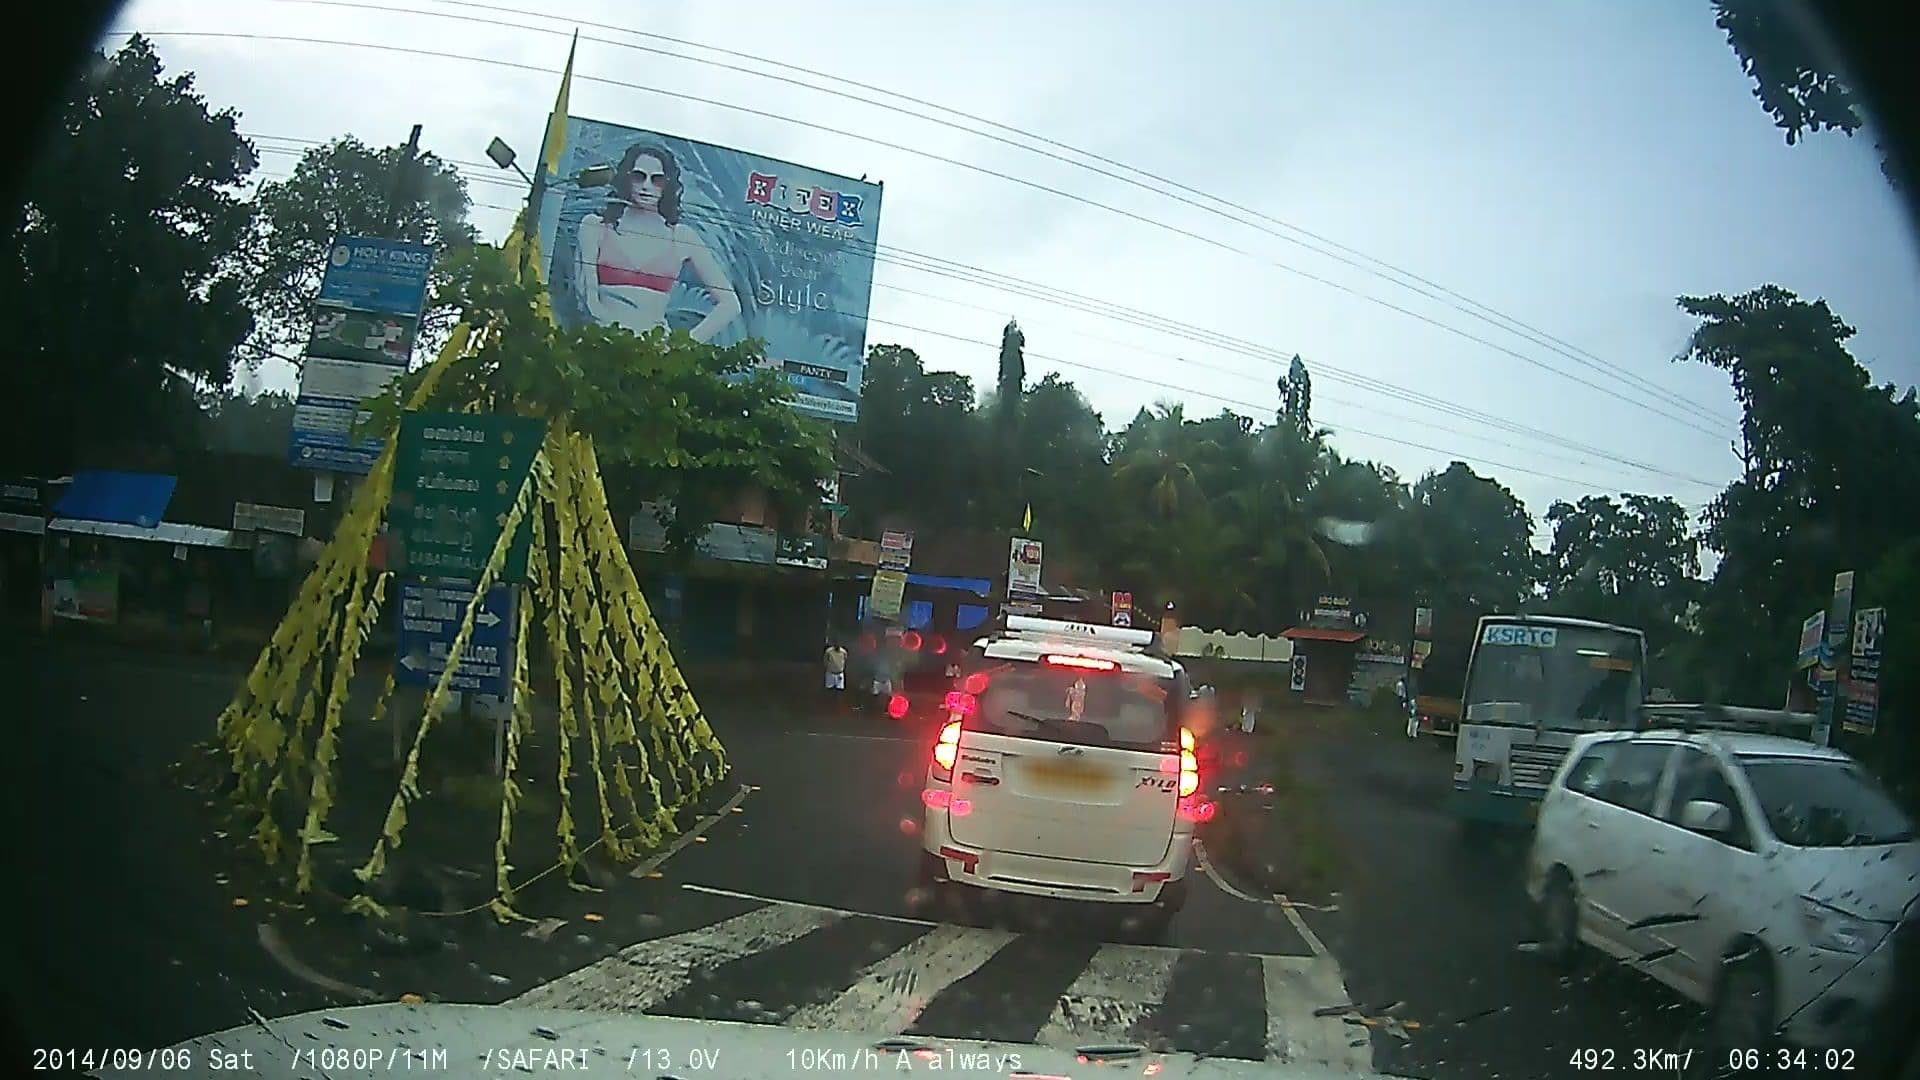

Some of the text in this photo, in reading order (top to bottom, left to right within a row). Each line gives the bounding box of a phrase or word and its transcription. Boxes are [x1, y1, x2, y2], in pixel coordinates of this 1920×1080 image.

[749, 174, 860, 223] KITEX
[751, 209, 801, 231] INNER
[353, 247, 386, 259] HOLY
[757, 280, 828, 315] Style
[1487, 627, 1553, 645] KSRTC
